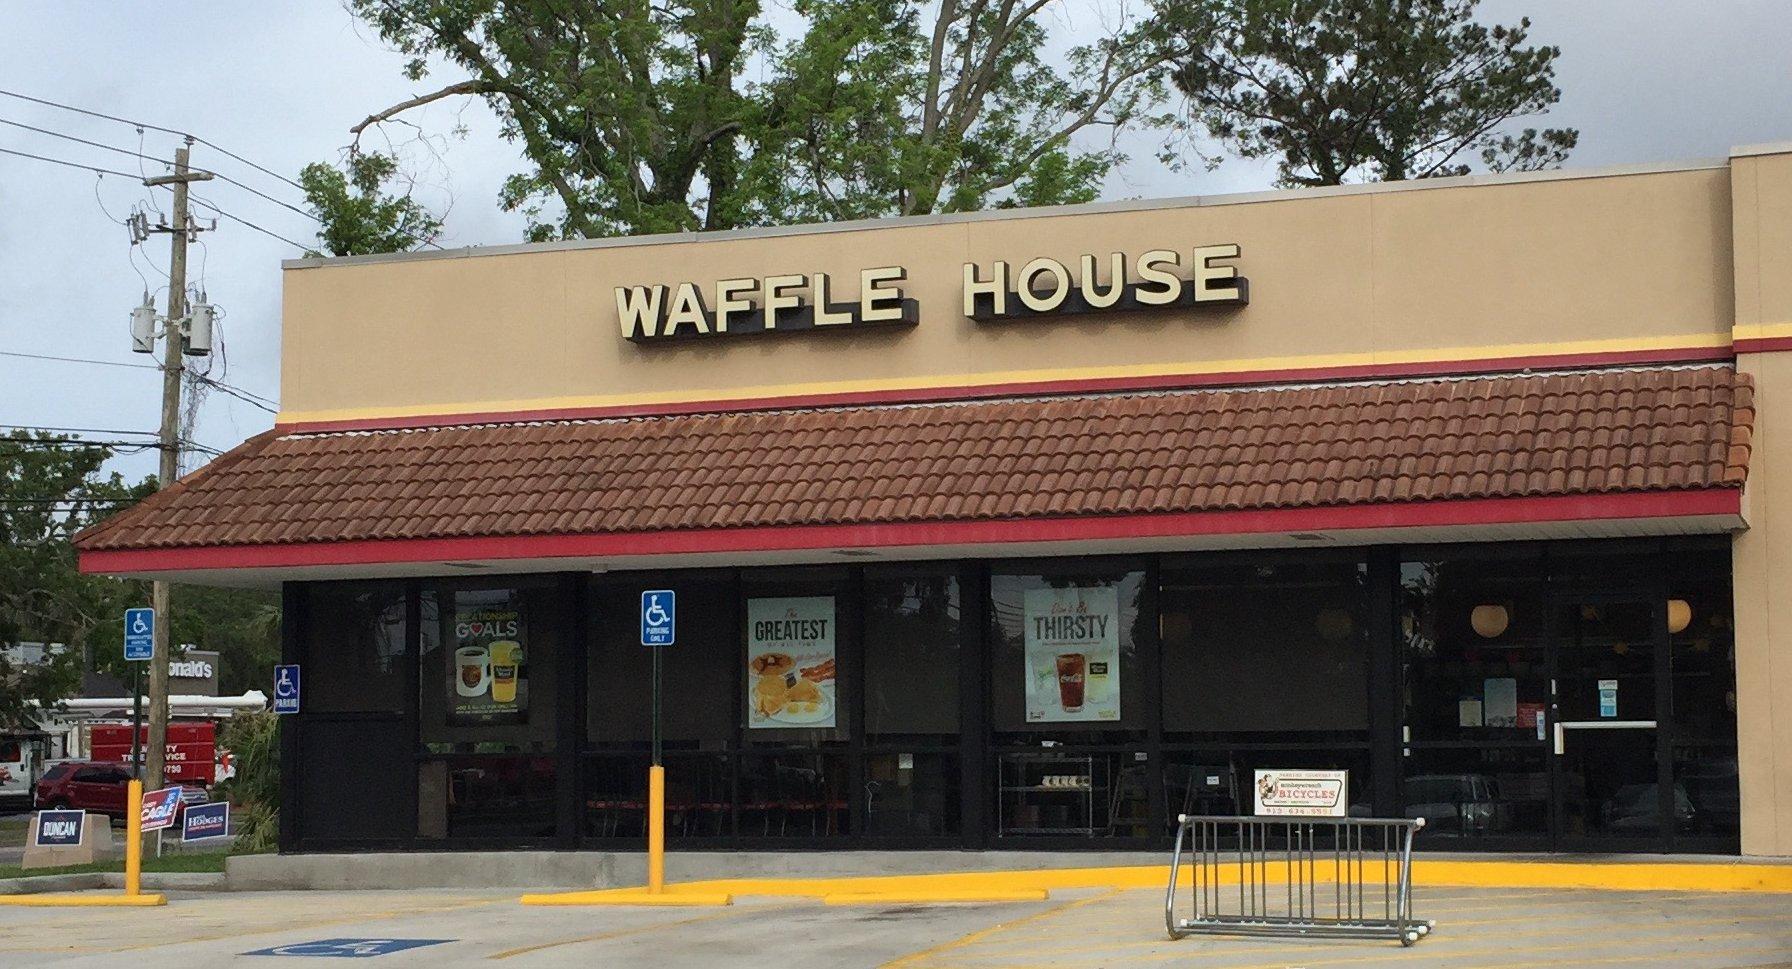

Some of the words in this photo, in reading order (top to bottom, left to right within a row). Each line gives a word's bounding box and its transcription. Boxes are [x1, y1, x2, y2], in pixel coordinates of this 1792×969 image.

[614, 266, 906, 338] WAFFLE
[963, 243, 1241, 317] HOUSE
[646, 627, 670, 635] PARKING
[755, 620, 828, 642] GREATEST
[1033, 615, 1109, 640] THIRSTY
[168, 661, 213, 678] onald's
[121, 753, 145, 762] TRE
[1279, 790, 1335, 799] BICYCLES
[43, 821, 77, 836] DUNCAN
